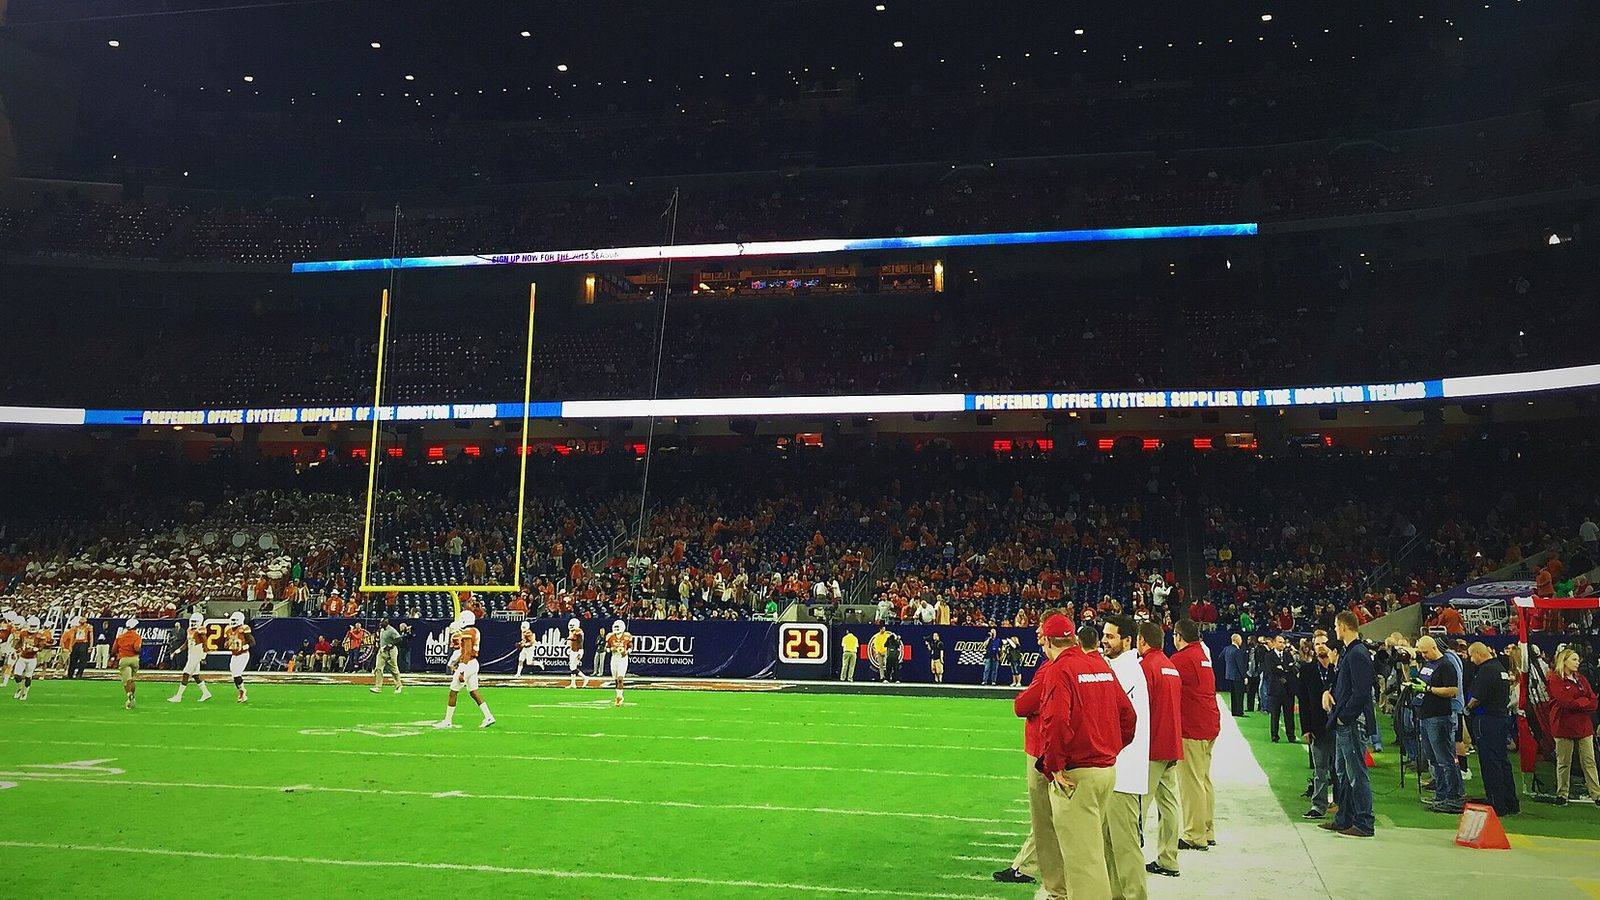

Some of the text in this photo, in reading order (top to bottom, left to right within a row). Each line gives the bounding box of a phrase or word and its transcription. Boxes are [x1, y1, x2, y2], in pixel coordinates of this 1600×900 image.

[510, 255, 520, 263] UP
[522, 254, 537, 262] NOW
[540, 253, 554, 261] FOR
[975, 394, 1048, 410] PREFERRED
[1052, 393, 1097, 409] OFFICE
[1101, 392, 1166, 408] SYSTEMS
[1171, 391, 1238, 407] SUPPLIER
[1242, 391, 1260, 406] OF
[1264, 389, 1291, 405] THE
[1368, 382, 1425, 402] TEXANS
[143, 411, 204, 424] PREFERRED
[208, 410, 243, 423] OFFICE
[246, 409, 297, 422] SYSTEMS
[301, 408, 352, 421] SUPPLIER
[356, 407, 370, 420] OF
[632, 635, 695, 653] TDECU
[786, 630, 820, 659] 25
[629, 656, 694, 665] YOUR CREDIT UNION
